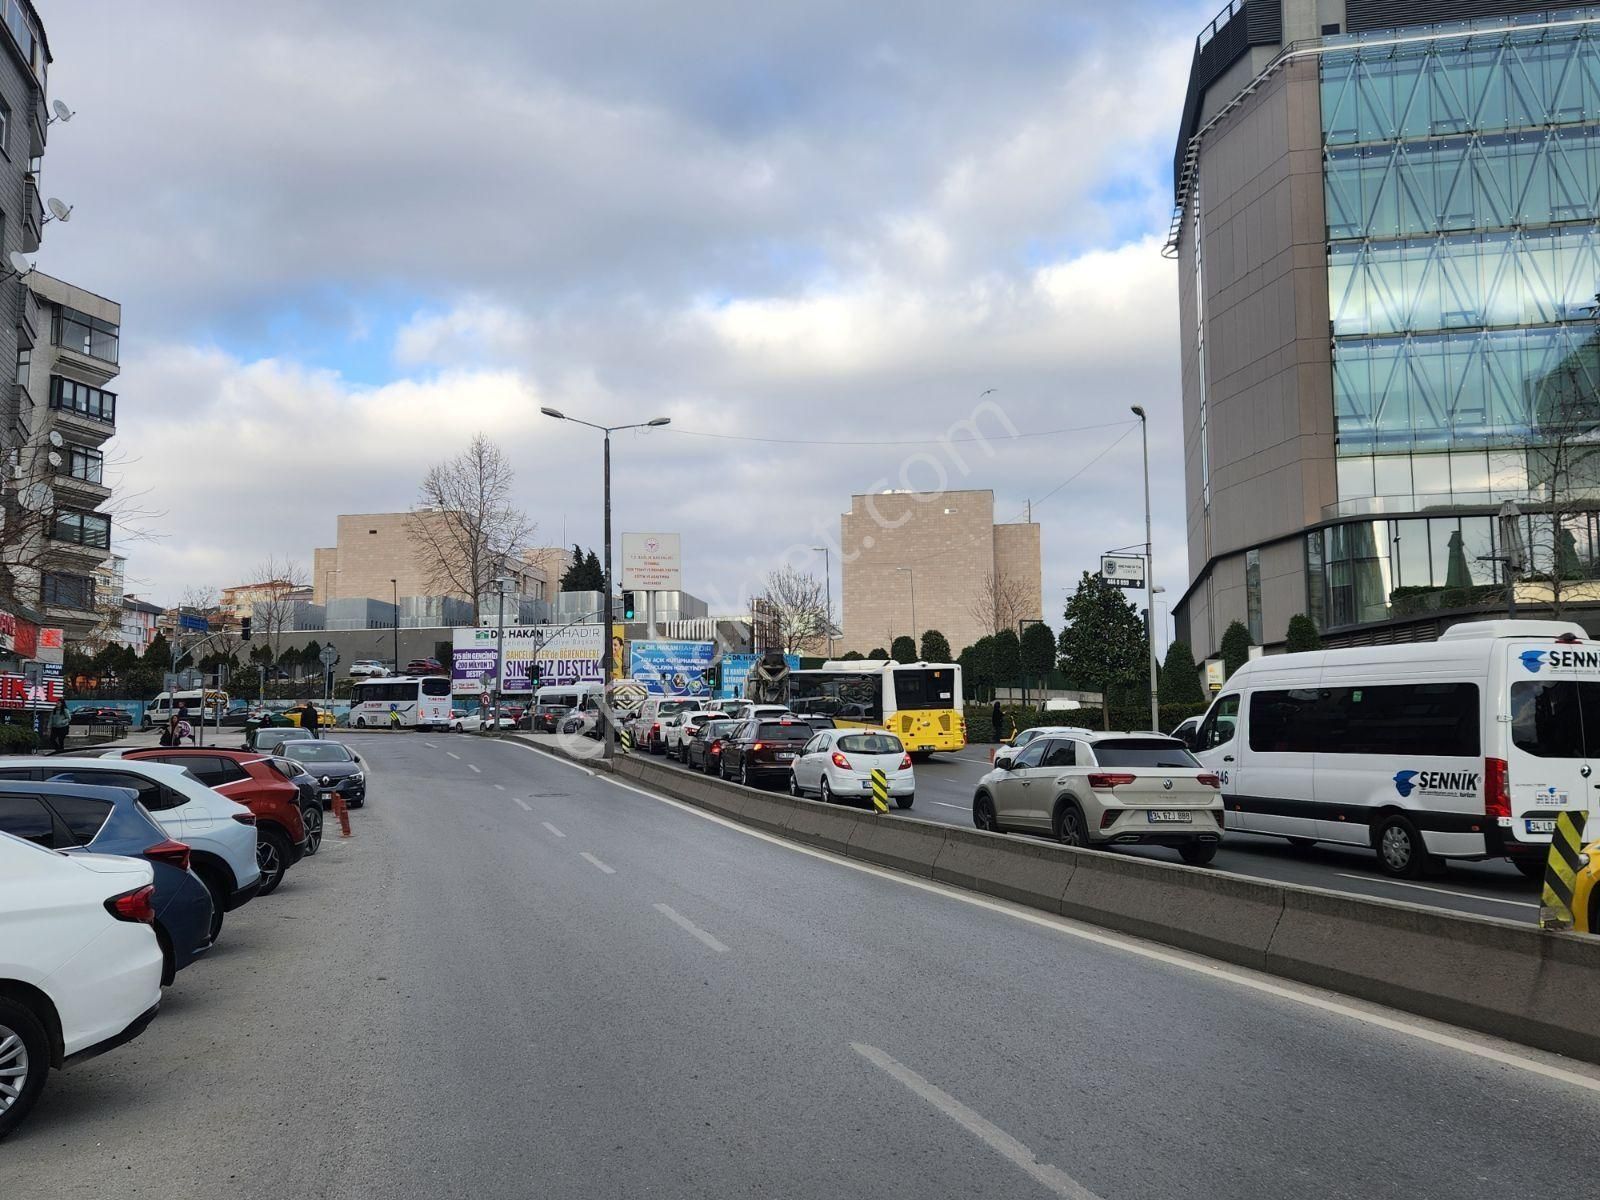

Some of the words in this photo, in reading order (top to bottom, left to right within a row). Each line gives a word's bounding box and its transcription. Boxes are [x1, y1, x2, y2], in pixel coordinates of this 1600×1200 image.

[508, 629, 543, 639] HAKAN
[545, 628, 600, 638] BAHADIR
[557, 659, 600, 676] DESTEK
[1549, 649, 1600, 669] ŞENN
